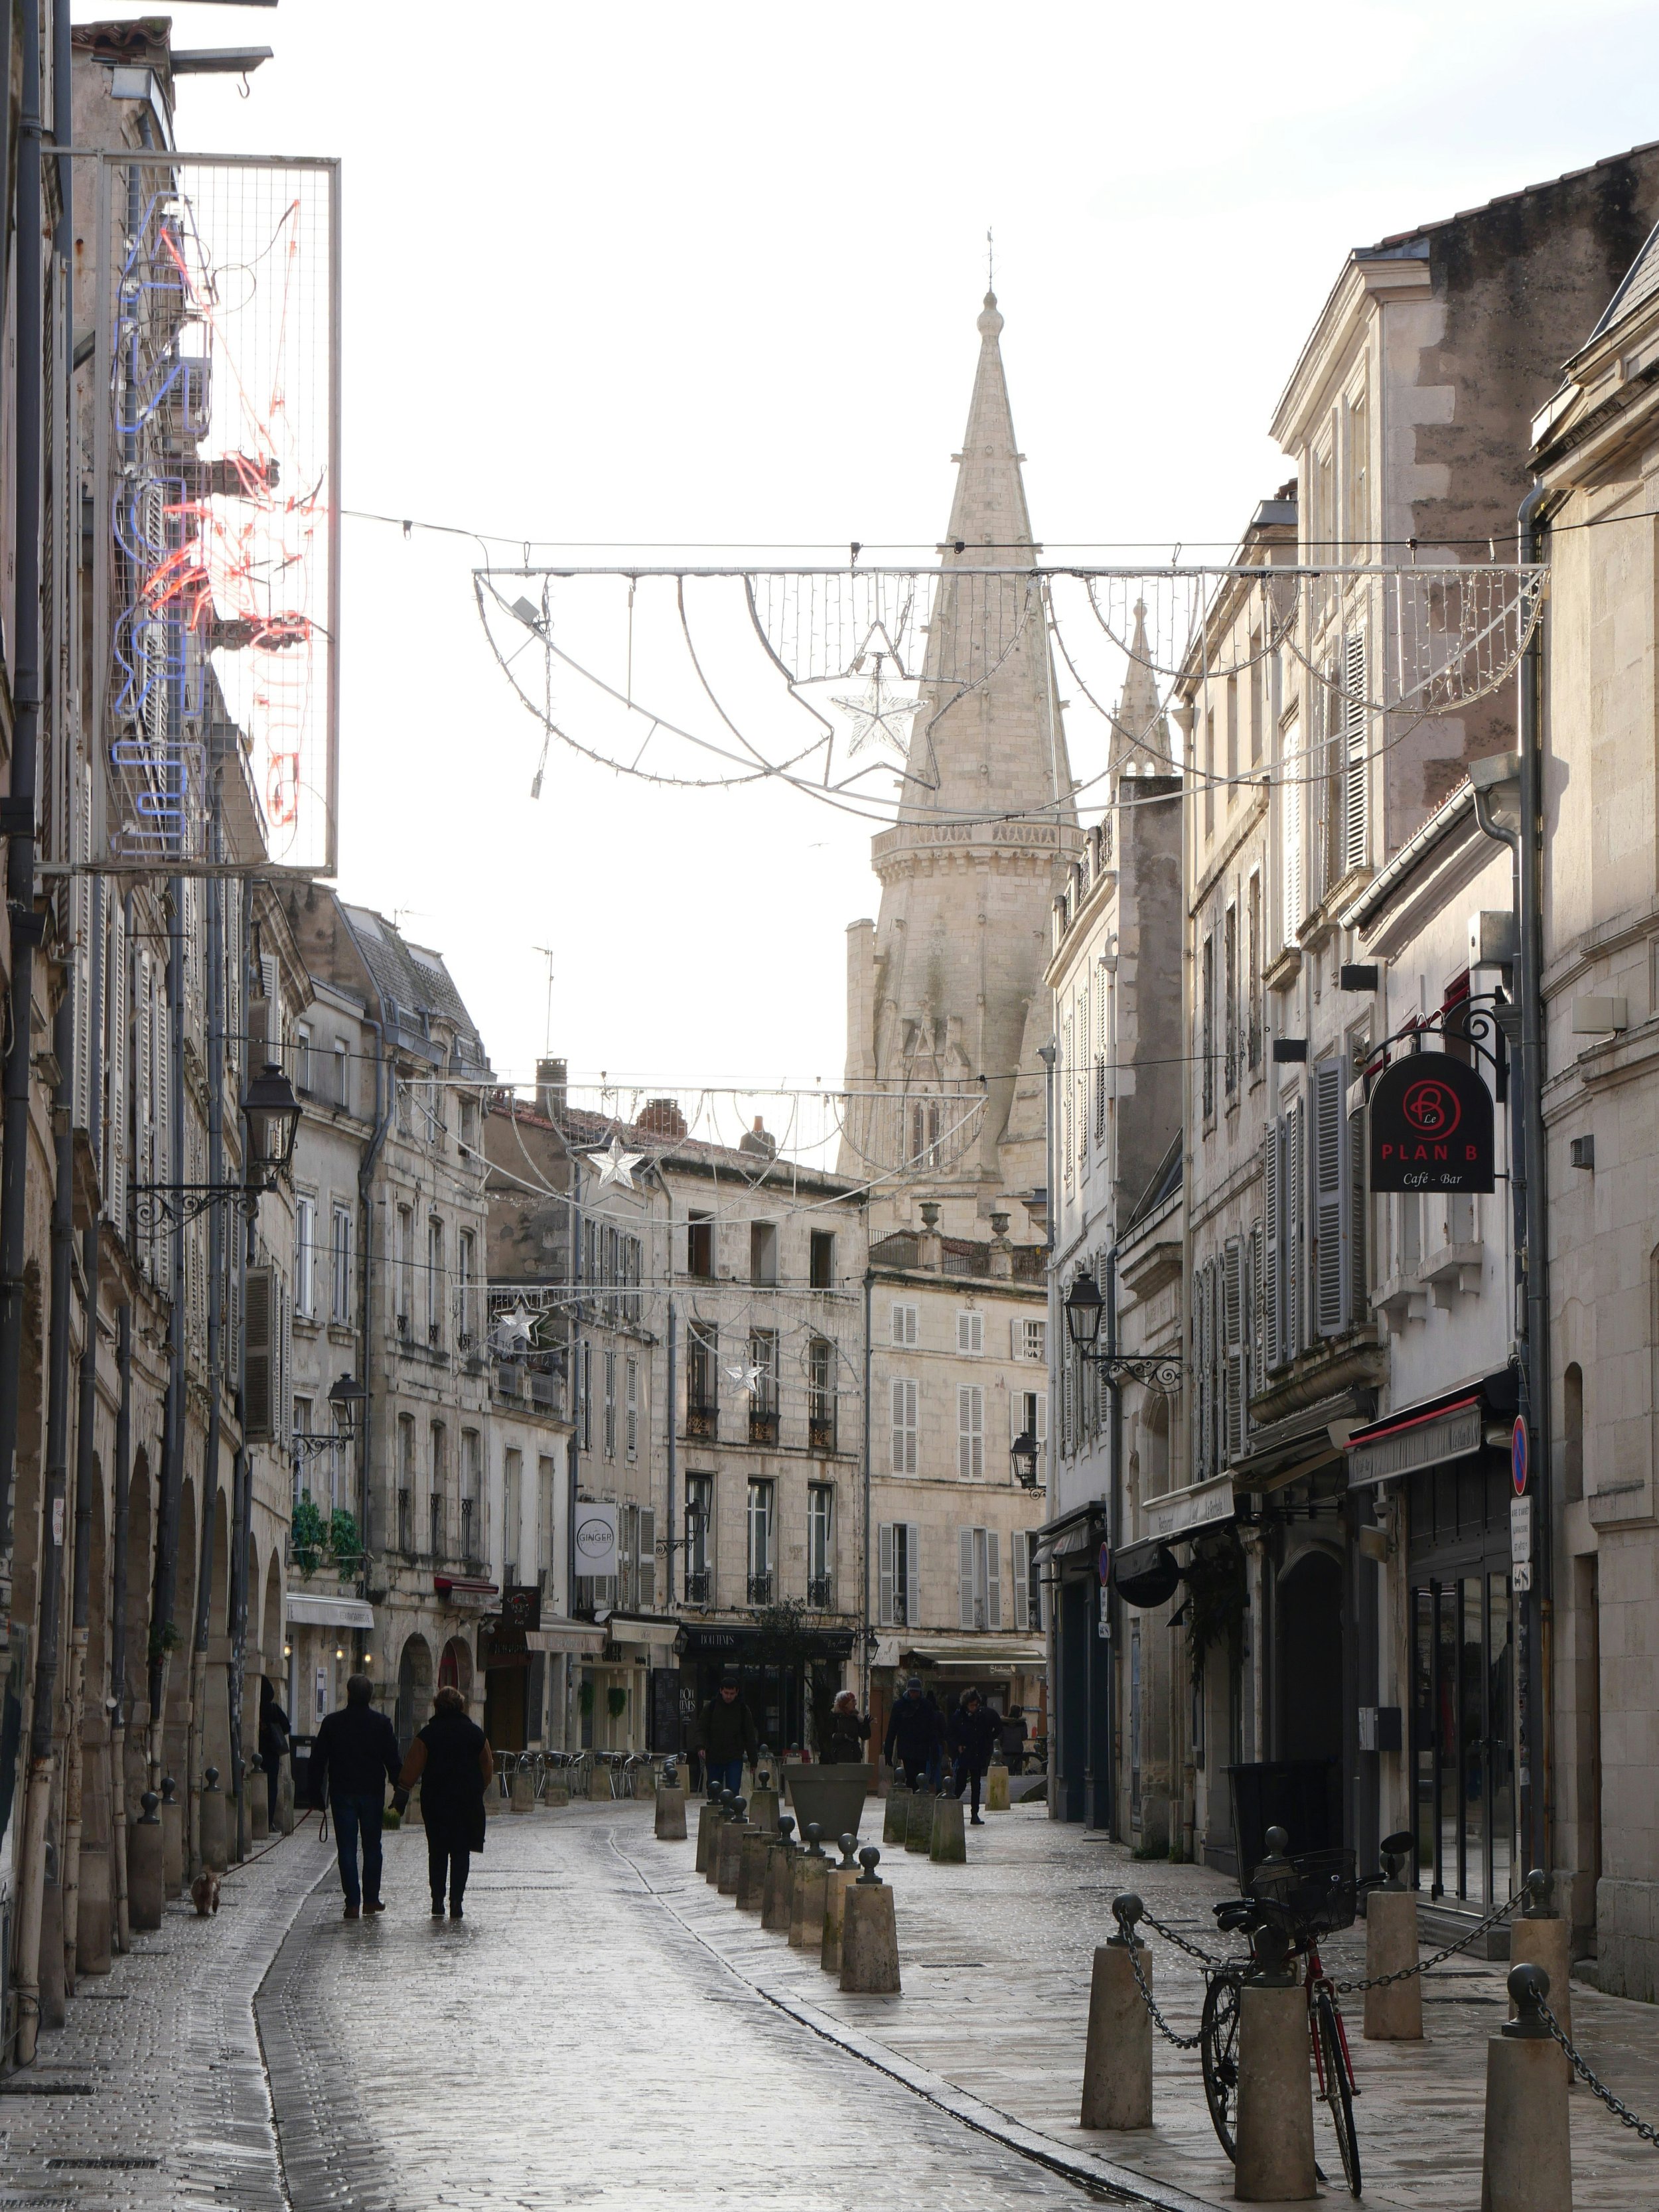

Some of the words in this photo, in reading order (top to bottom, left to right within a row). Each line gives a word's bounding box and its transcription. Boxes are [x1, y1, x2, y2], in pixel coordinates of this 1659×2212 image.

[1423, 1114, 1437, 1124] Le
[1382, 1144, 1448, 1161] PLAN
[1466, 1145, 1478, 1161] B
[1403, 1172, 1429, 1187] Café
[1440, 1173, 1463, 1184] Bar
[579, 1533, 612, 1542] GINGER
